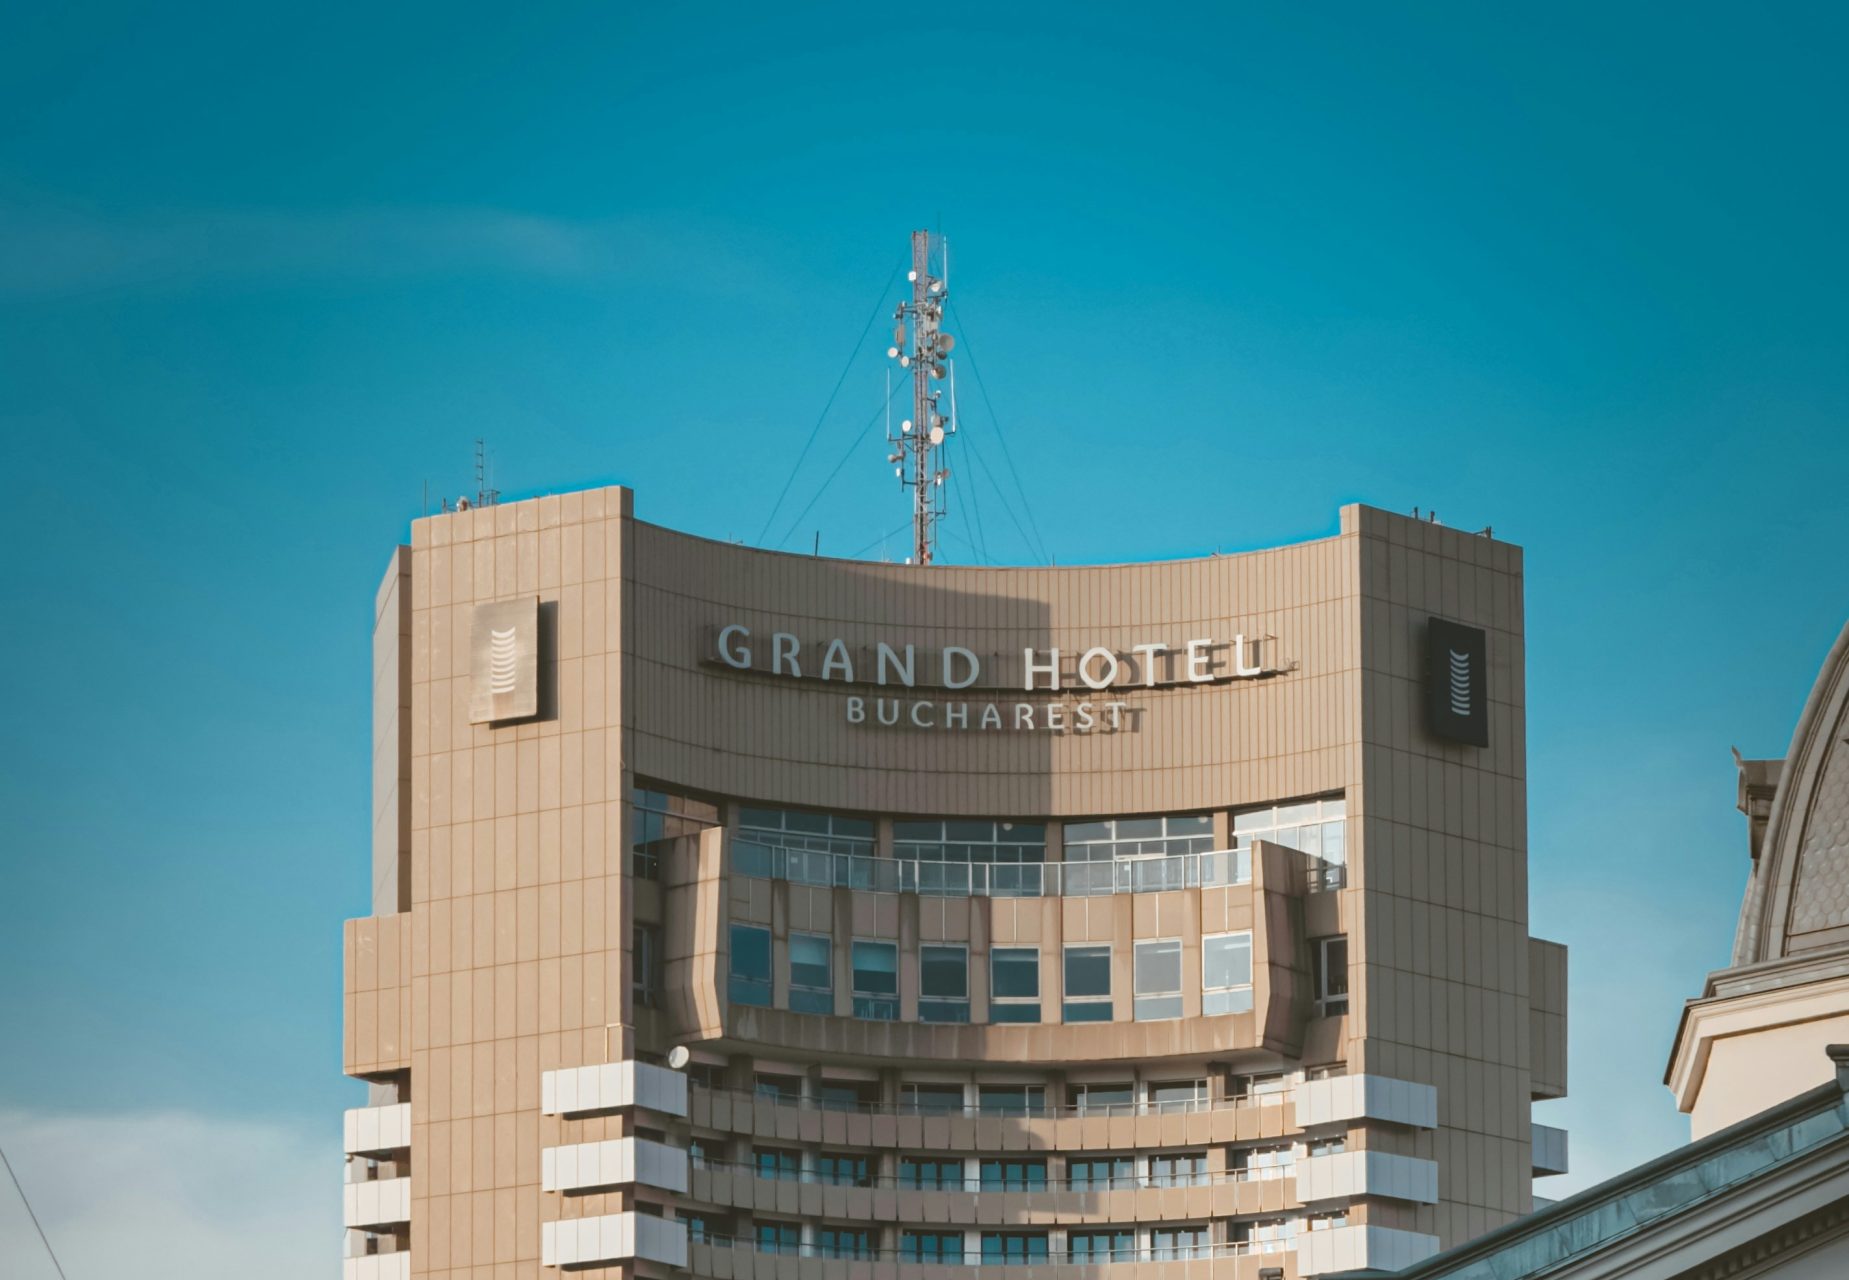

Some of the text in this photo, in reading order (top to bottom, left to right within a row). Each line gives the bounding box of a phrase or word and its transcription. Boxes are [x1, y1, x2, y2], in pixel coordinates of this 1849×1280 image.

[718, 624, 1261, 691] GRAND HOTEL
[847, 696, 1127, 732] BUCHAREST
